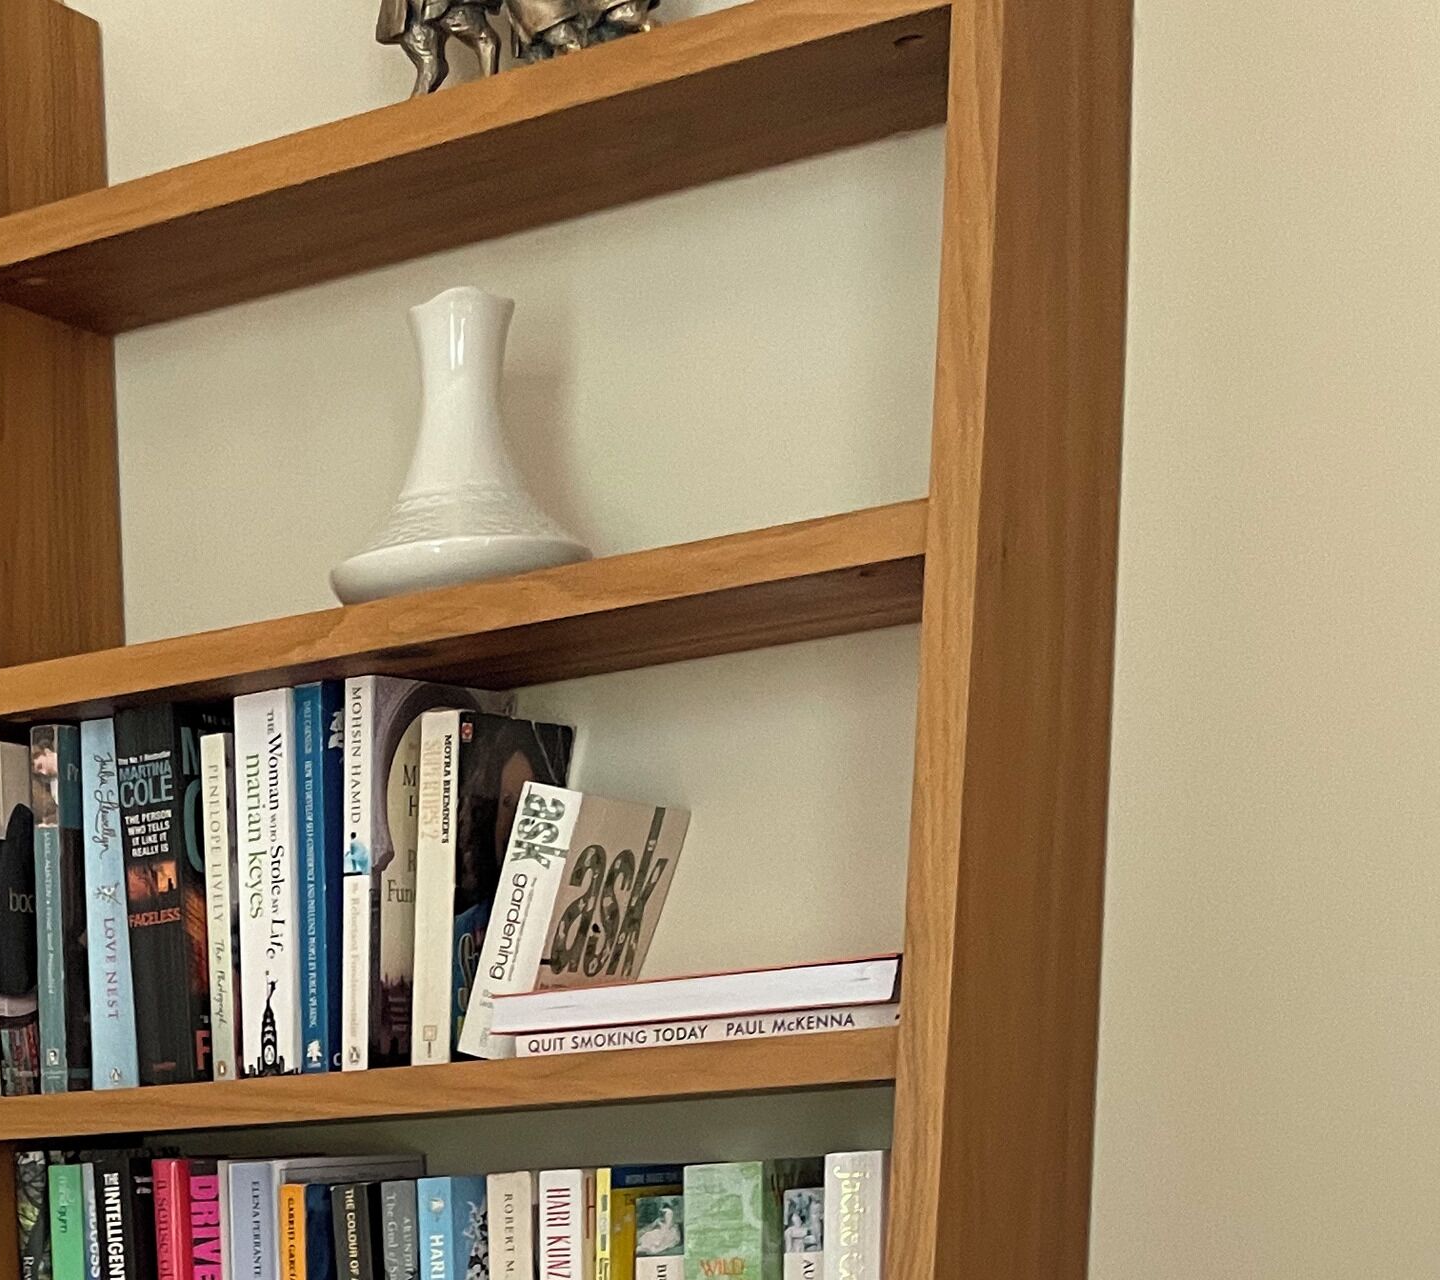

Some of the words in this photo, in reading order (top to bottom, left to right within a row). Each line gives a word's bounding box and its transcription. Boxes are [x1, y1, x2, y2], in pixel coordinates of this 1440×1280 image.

[266, 709, 275, 733] THE
[351, 686, 363, 758] MOHSIN
[93, 751, 115, 786] Julia
[119, 760, 173, 781] MARTINA
[266, 733, 283, 811] Woman
[443, 734, 452, 780] MOYRA
[119, 774, 174, 808] COLE
[208, 763, 222, 854] PENELOPE
[245, 753, 266, 843] marian
[350, 764, 361, 824] HAMID
[147, 820, 170, 833] TELLS
[510, 785, 570, 870] ask
[212, 863, 224, 923] LIVELY
[244, 850, 268, 919] keyes
[270, 845, 285, 896] Stole
[550, 806, 670, 978] ask
[128, 906, 181, 928] FACELESS
[266, 919, 285, 959] Life
[489, 872, 528, 981] gardening
[103, 917, 116, 965] LOVE
[105, 971, 119, 1019] NEST
[527, 1037, 565, 1055] QUIT
[570, 1030, 648, 1050] SMOKING
[653, 1024, 709, 1042] TODAY
[725, 1019, 766, 1037] PAUL
[771, 1012, 856, 1034] McKENNA
[251, 1180, 260, 1218] ELENA
[345, 1188, 355, 1209] THE
[386, 1194, 397, 1217] The
[546, 1187, 571, 1228] HARI
[157, 1194, 169, 1259] sense
[346, 1212, 358, 1258] COLOUR
[387, 1220, 399, 1249] God
[503, 1193, 515, 1253] ROBERT
[349, 1260, 360, 1275] OF
[429, 1235, 445, 1280] HARI
[504, 1260, 515, 1280] M.
[699, 1256, 747, 1277] WILD
